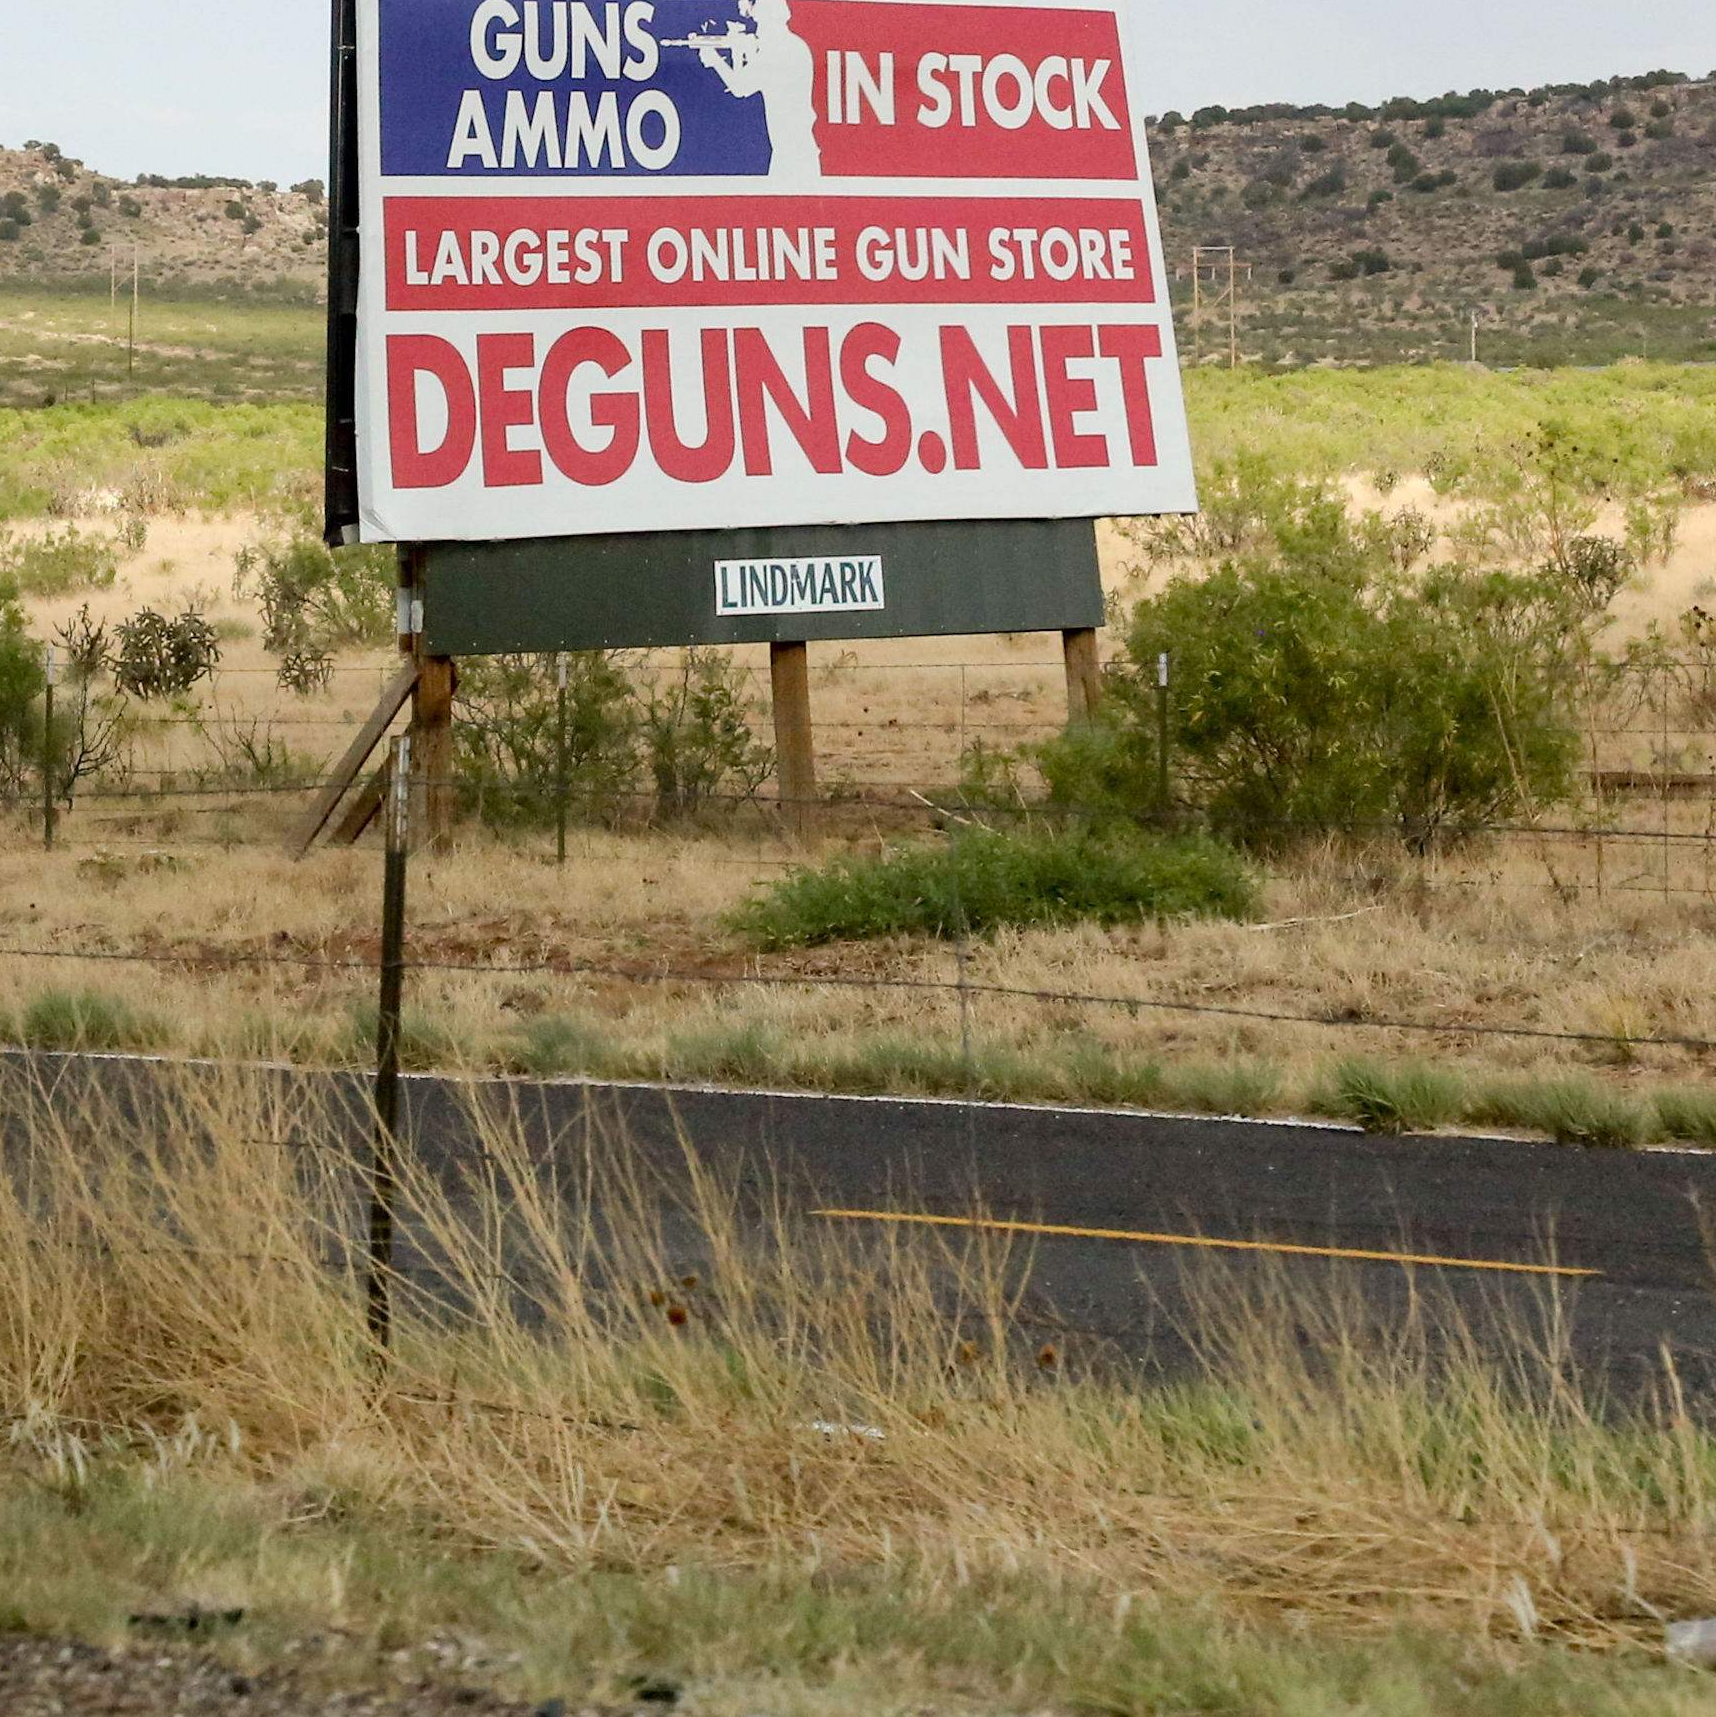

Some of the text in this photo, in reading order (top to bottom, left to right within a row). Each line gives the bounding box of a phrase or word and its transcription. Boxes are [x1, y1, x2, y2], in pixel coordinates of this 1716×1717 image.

[446, 89, 681, 172] AMMO
[826, 50, 1121, 131] IN STOCK
[404, 226, 1135, 288] LARGEST ONLINE GUN STORE
[385, 321, 1161, 489] DEGUNS.NET
[719, 559, 880, 610] LINDMARK
